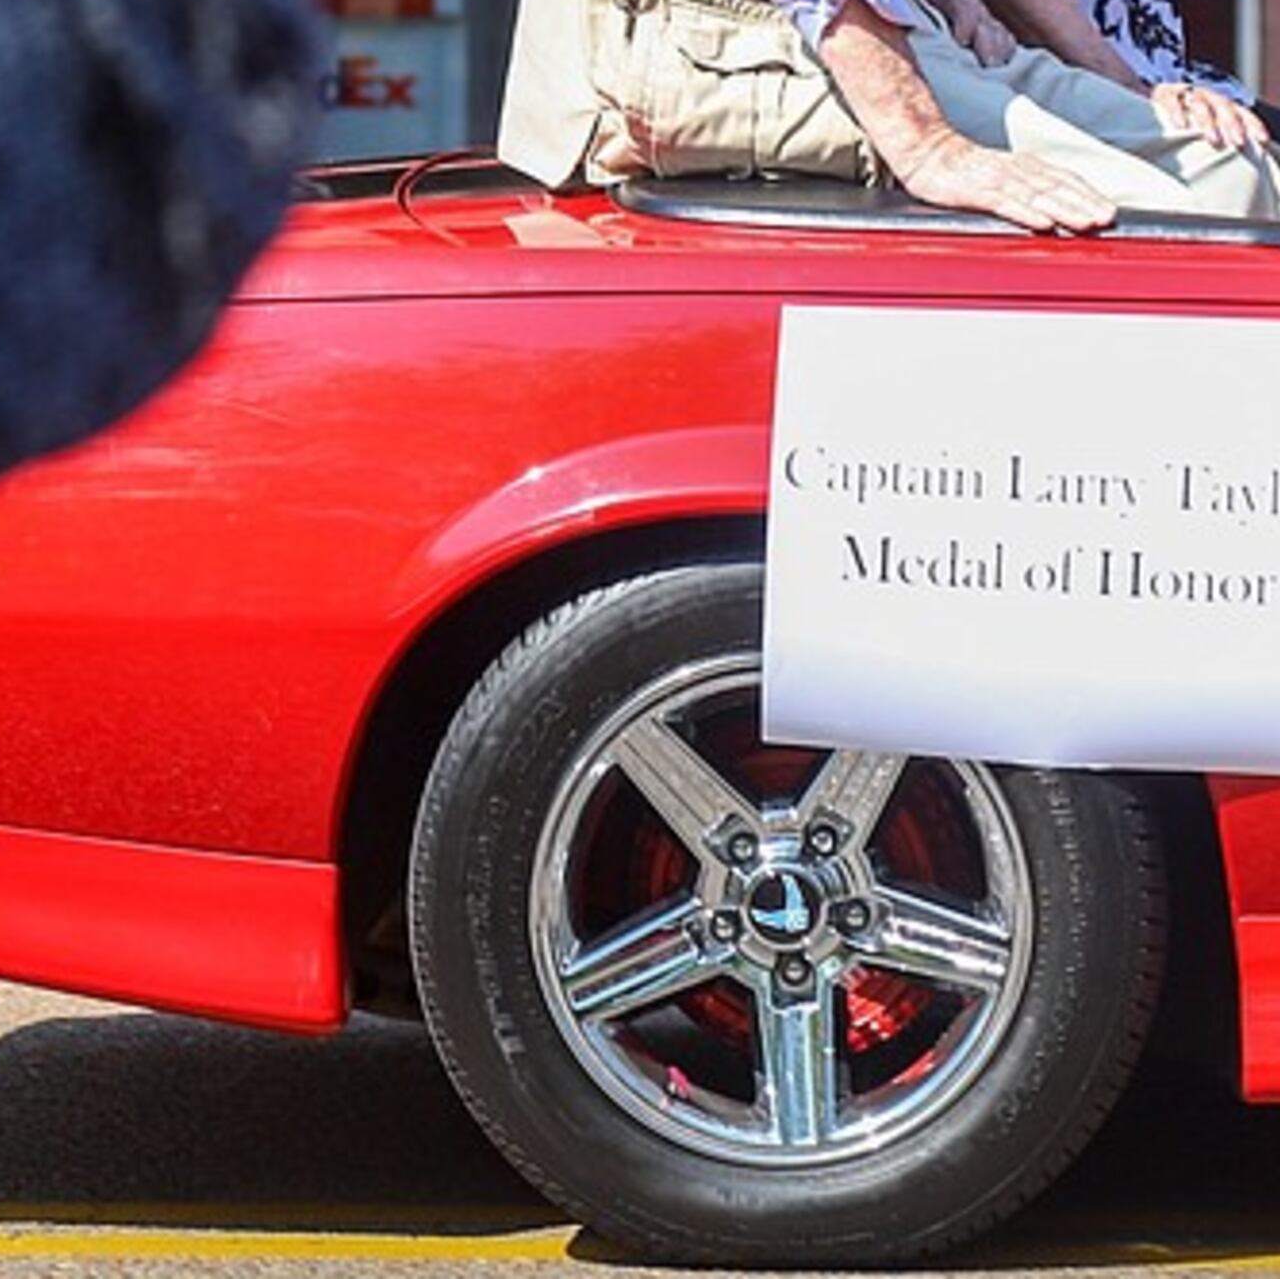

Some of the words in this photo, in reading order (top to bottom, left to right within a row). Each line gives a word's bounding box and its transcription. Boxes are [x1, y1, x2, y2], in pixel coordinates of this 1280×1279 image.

[784, 446, 983, 504] Captain
[1008, 454, 1144, 519] Larry
[841, 533, 1004, 591] Medal
[1023, 545, 1084, 595] of
[1098, 548, 1278, 607] Honor
